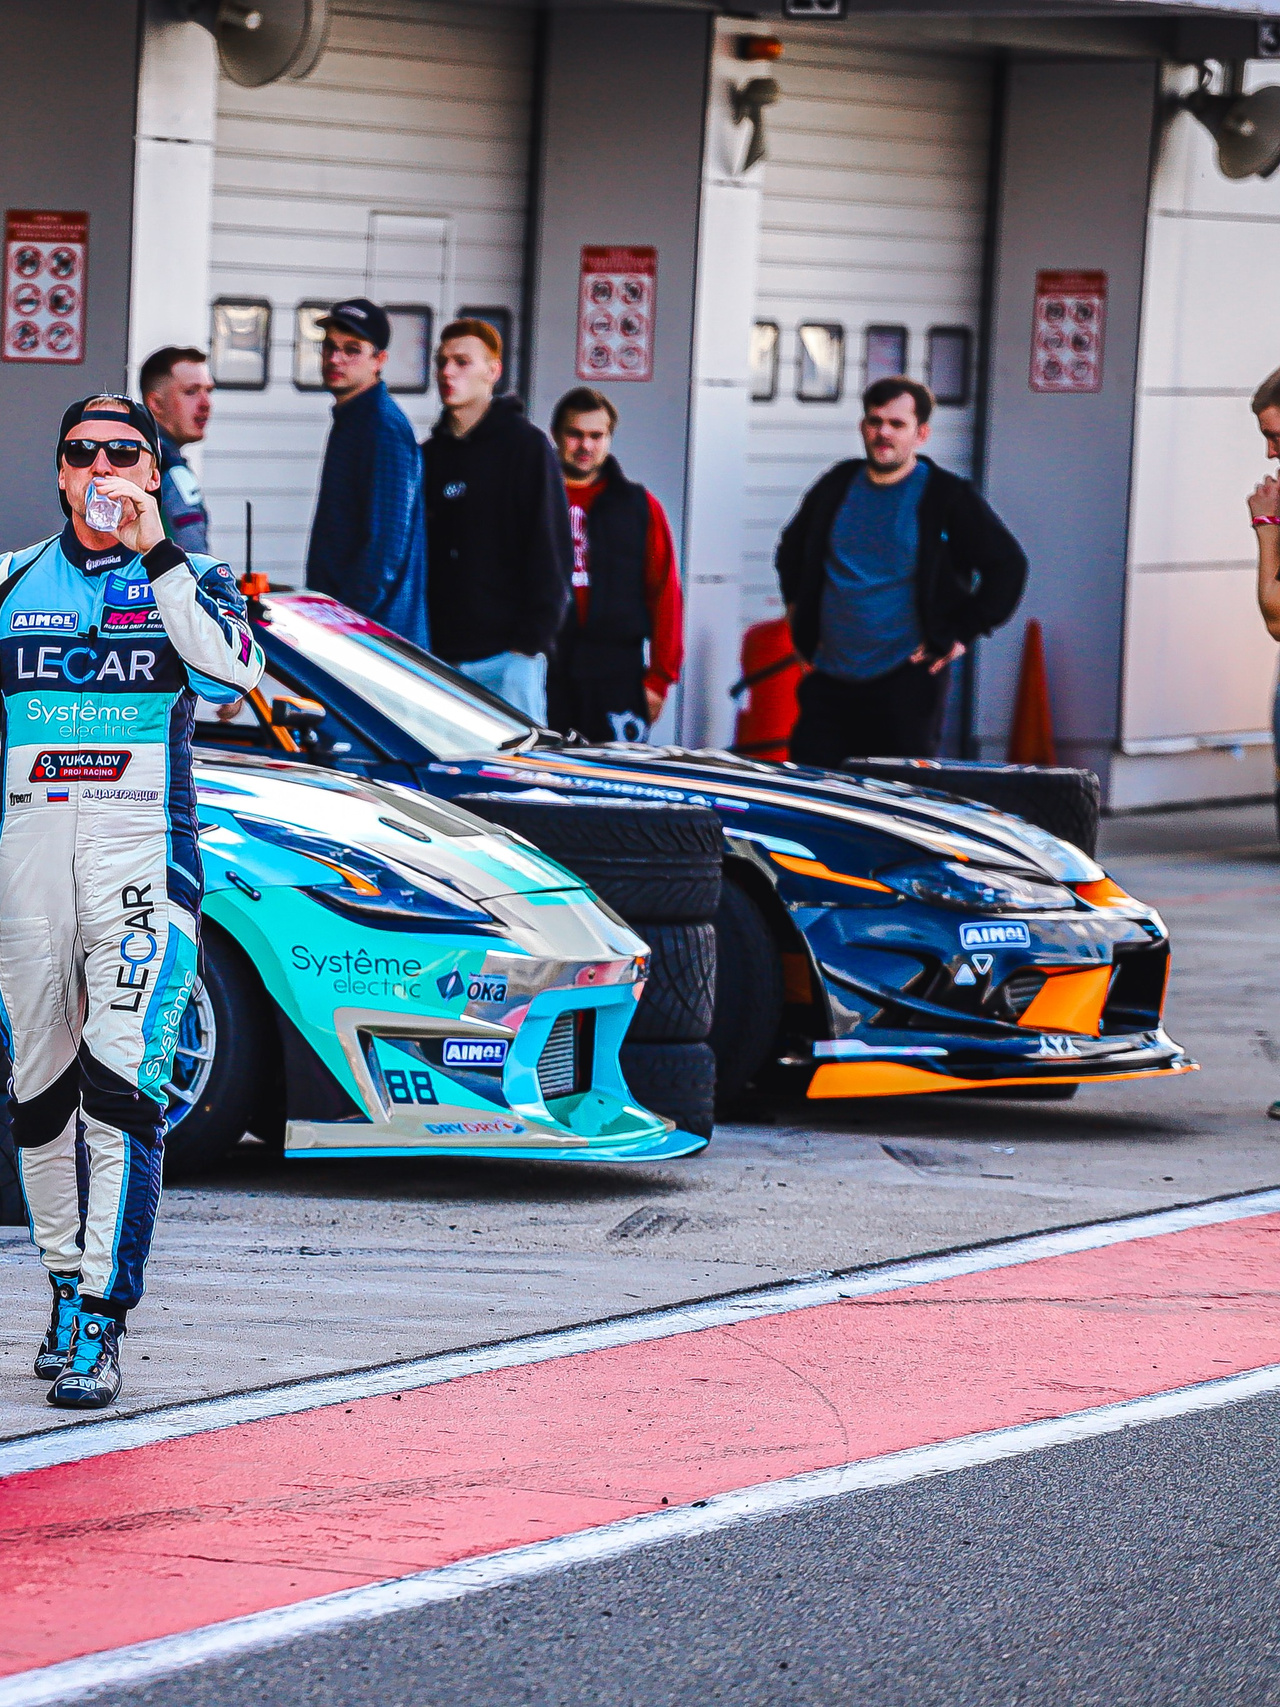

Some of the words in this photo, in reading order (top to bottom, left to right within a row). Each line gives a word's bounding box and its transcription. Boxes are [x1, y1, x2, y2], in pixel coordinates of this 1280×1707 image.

[127, 583, 151, 600] ВТ
[13, 614, 74, 628] AIMOL
[17, 646, 156, 684] LECAR
[27, 698, 139, 724] Système
[59, 721, 138, 738] electric
[95, 755, 121, 766] ADV
[109, 883, 158, 1013] LECAR
[291, 945, 421, 976] Système
[333, 974, 421, 999] electric
[145, 969, 195, 1080] Système
[446, 1044, 503, 1061] AIMOL
[384, 1069, 440, 1106] 88
